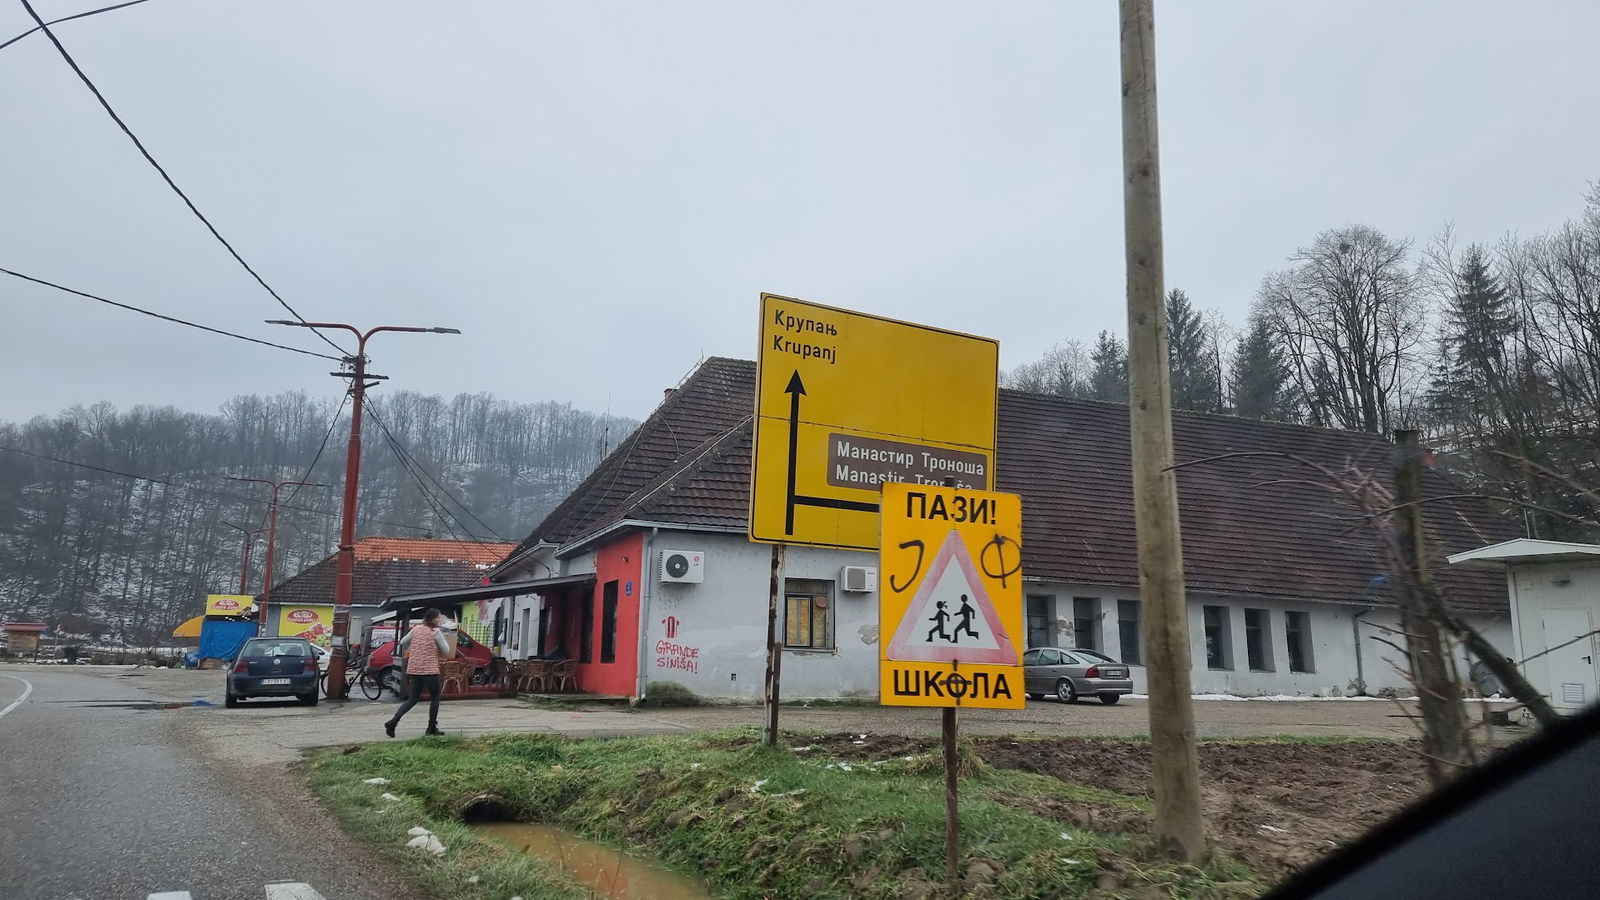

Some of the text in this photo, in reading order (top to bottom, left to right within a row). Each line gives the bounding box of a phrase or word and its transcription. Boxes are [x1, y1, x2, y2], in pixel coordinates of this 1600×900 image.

[775, 309, 838, 336] Крупањ
[773, 334, 836, 365] Krupanj
[837, 440, 984, 476] Манастир Троноша
[906, 491, 997, 525] ПАЗИ!
[656, 640, 699, 658] GRANDE
[893, 669, 1012, 700] ШКОЛА
